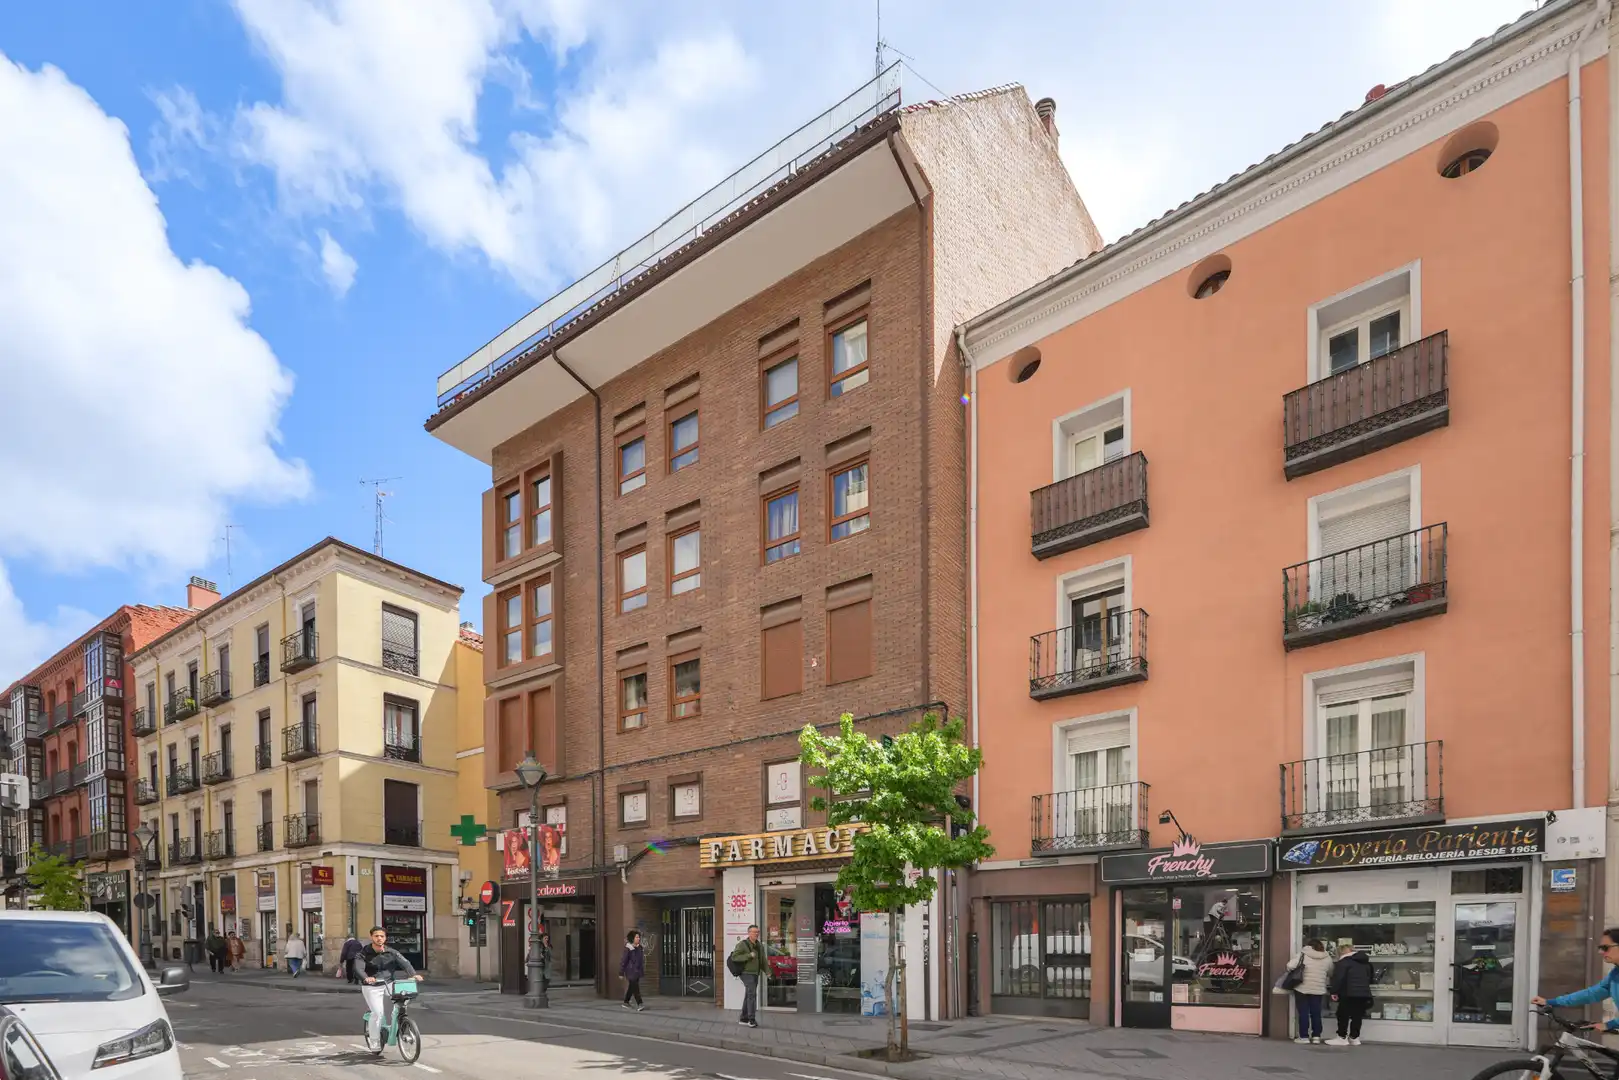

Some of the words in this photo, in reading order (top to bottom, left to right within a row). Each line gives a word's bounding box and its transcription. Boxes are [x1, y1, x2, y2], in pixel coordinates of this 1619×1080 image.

[709, 828, 859, 863] FARMACI
[1316, 834, 1408, 865] Joyería
[1416, 825, 1538, 852] Pariente
[1359, 849, 1465, 865] JOYERÍA-RELOJERÍA
[1468, 847, 1506, 857] DESDE
[1509, 844, 1538, 854] 1965
[1147, 853, 1215, 878] Frenchy
[502, 900, 515, 924] Z
[731, 895, 747, 908] 365
[1198, 962, 1247, 981] Frenchy
